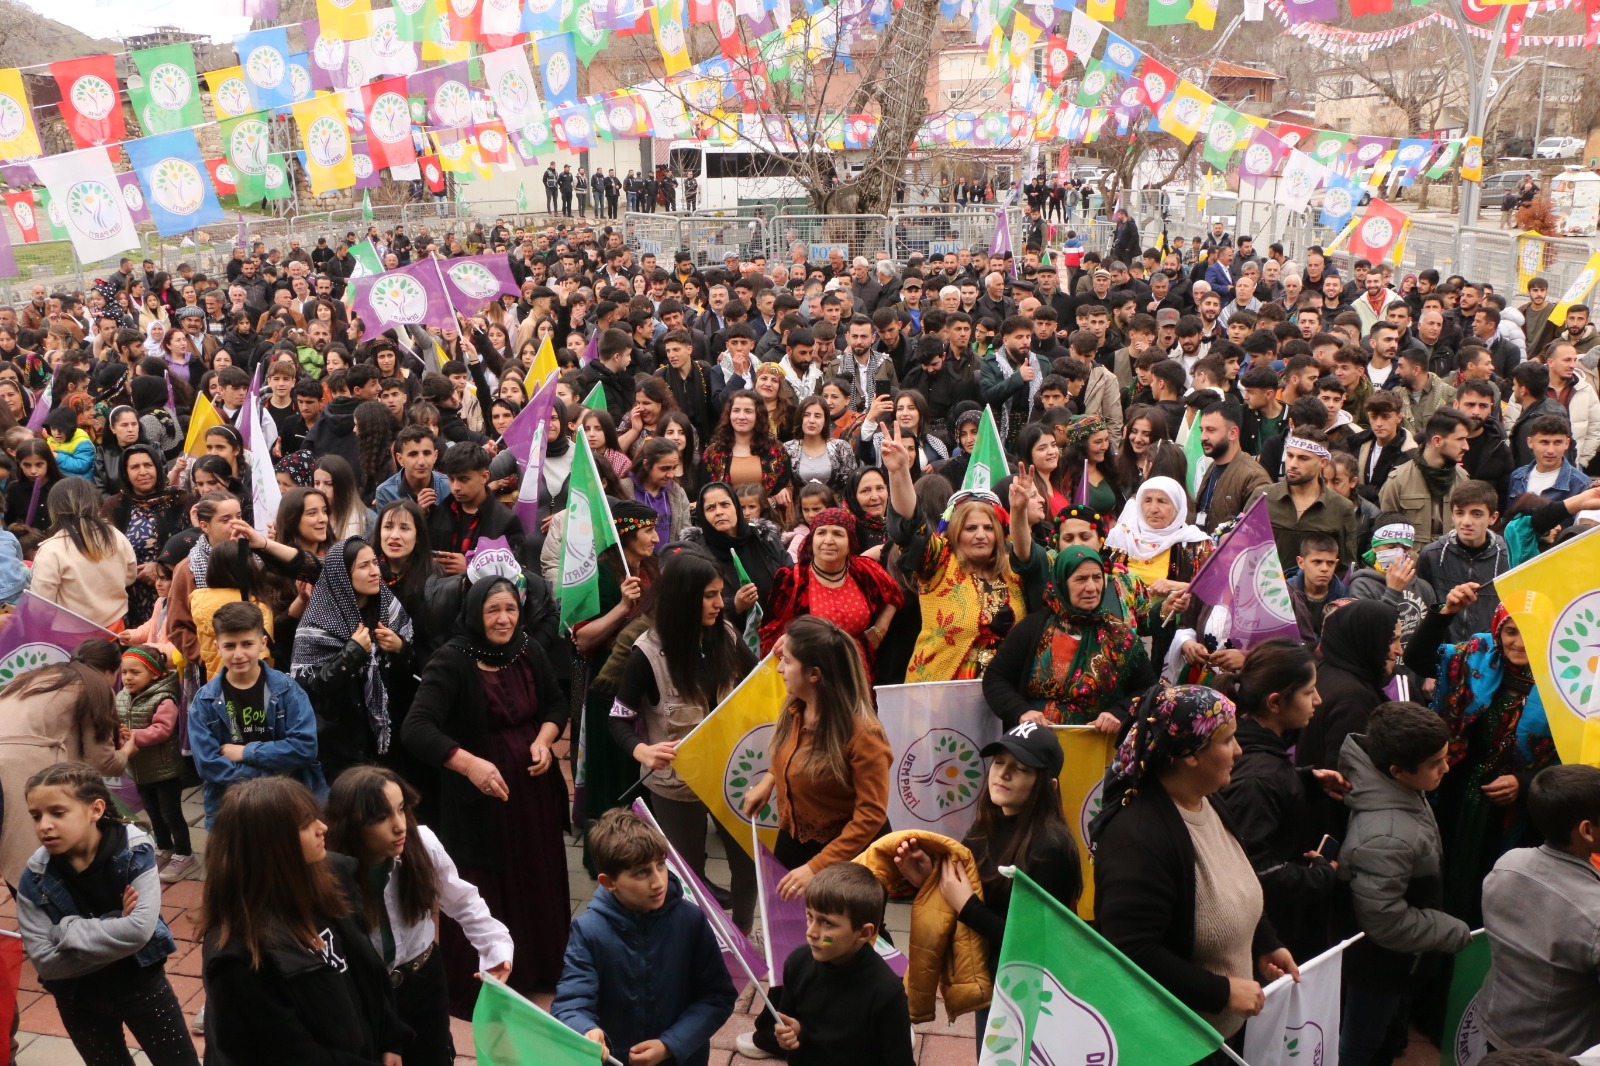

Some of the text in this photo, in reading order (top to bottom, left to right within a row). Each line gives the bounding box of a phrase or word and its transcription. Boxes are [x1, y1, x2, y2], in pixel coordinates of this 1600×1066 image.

[1382, 529, 1403, 538] DEM
[242, 707, 265, 725] Boy
[254, 725, 265, 734] boys
[900, 753, 921, 809] DEM PARTİ
